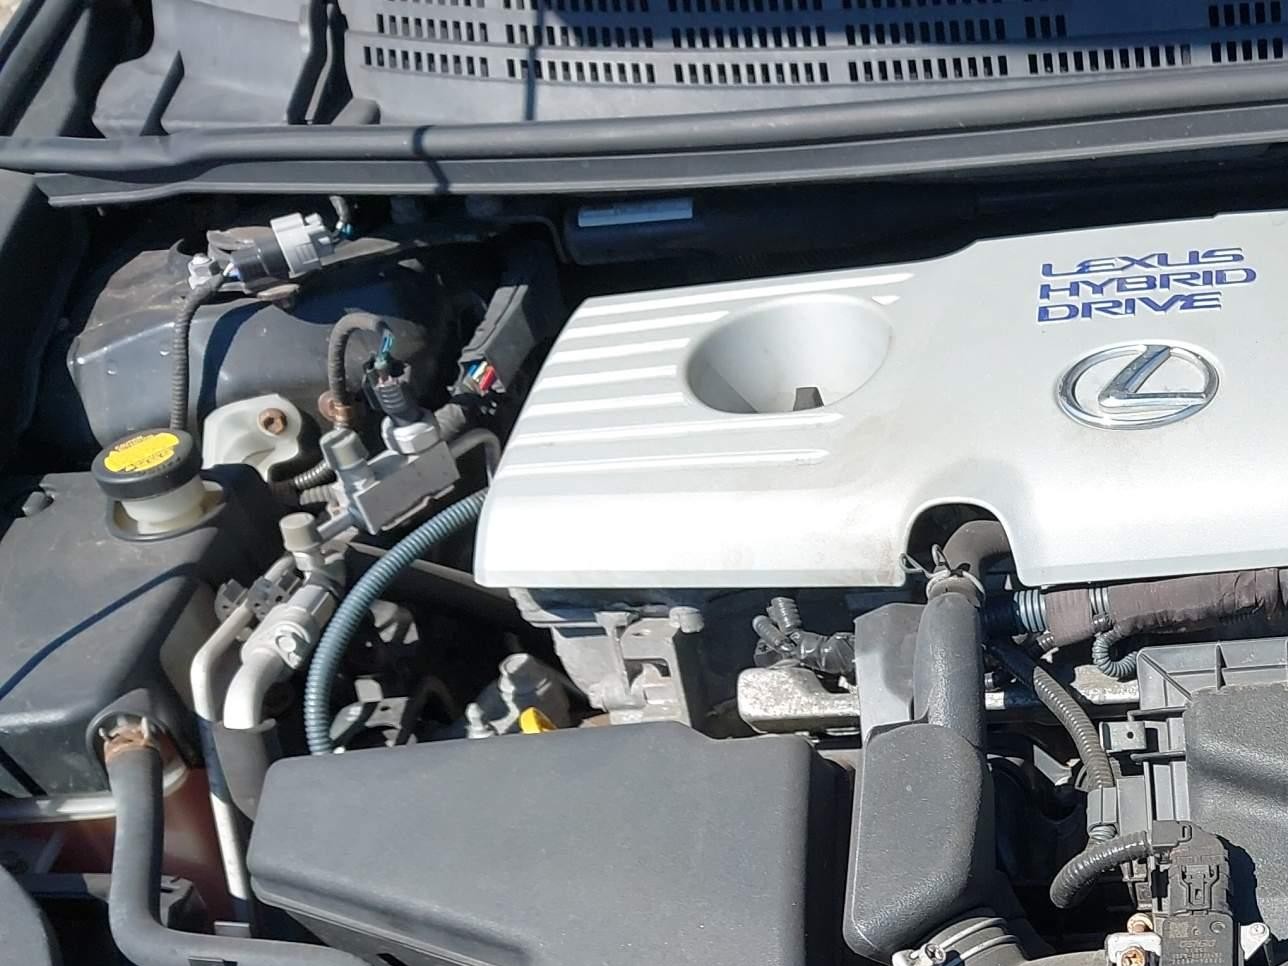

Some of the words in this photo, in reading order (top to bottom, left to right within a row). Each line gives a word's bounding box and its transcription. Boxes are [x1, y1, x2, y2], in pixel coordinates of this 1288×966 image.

[1041, 247, 1245, 277] LEXUS
[1039, 267, 1257, 300] HYBRID
[1037, 291, 1222, 323] DRIVE
